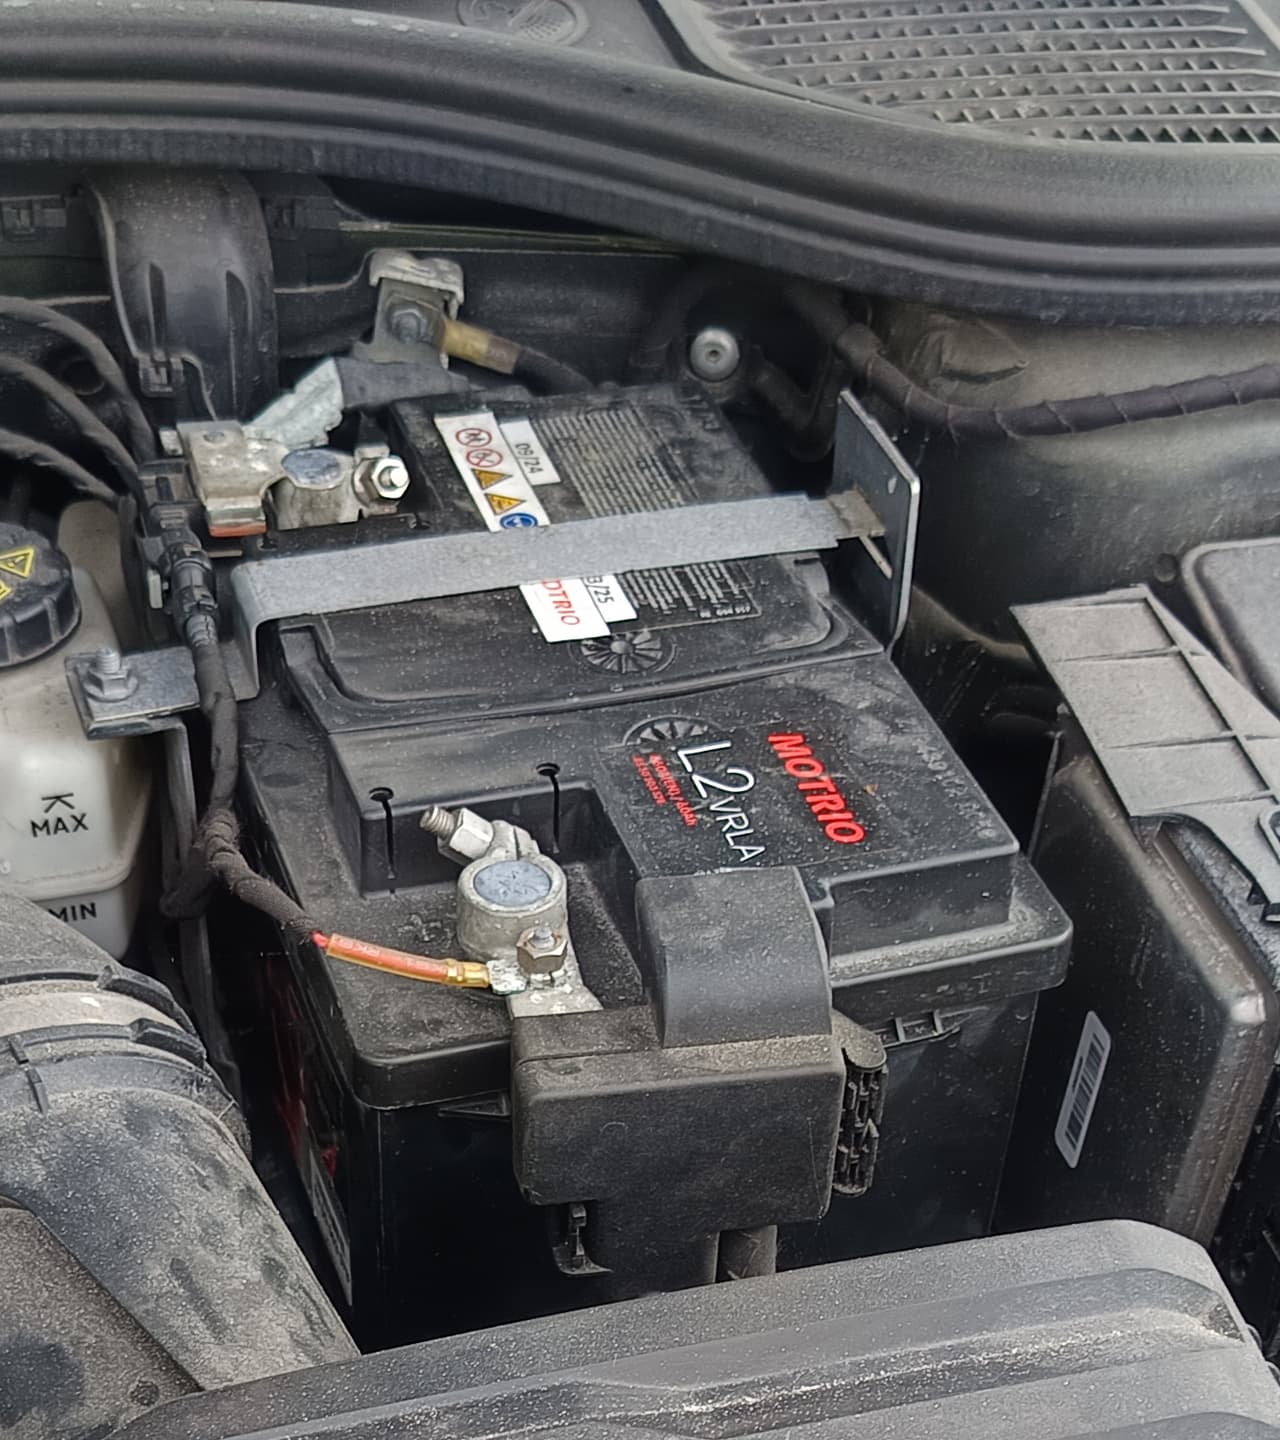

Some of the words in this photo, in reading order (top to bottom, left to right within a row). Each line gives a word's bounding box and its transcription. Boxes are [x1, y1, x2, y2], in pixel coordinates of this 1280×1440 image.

[515, 442, 544, 475] 09/24
[541, 577, 581, 627] OTRIO
[676, 740, 756, 799] L2
[768, 733, 866, 844] MOTRIO
[30, 812, 90, 838] MAX
[708, 796, 768, 862] VRLA
[47, 901, 98, 923] MIN
